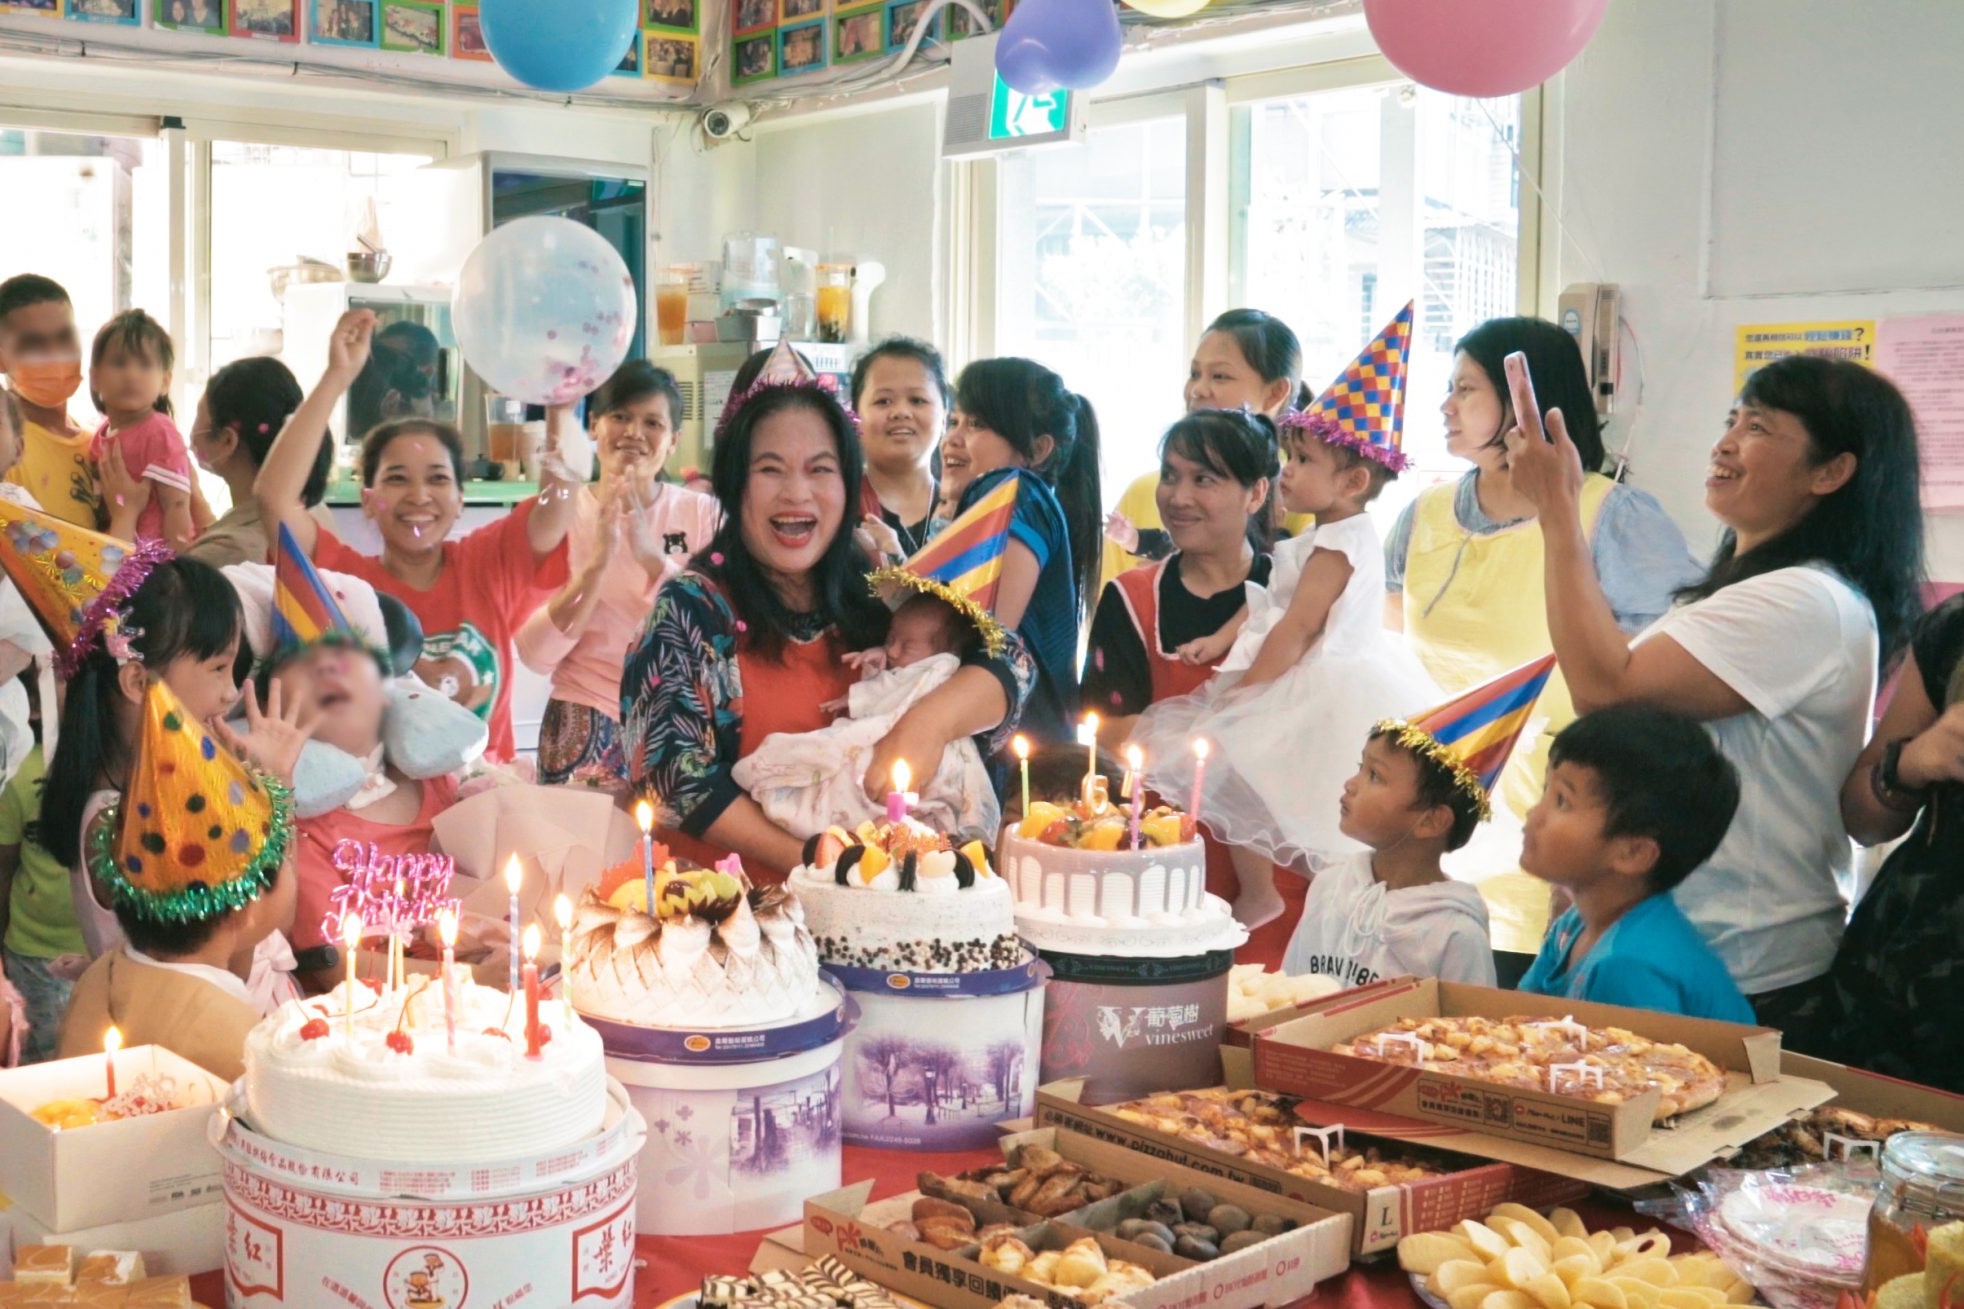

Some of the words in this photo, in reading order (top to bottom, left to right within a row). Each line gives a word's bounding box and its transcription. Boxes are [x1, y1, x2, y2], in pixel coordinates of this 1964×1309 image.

[333, 838, 455, 898] Happy
[1310, 955, 1344, 977] BRAV
[1146, 1004, 1199, 1028] 葡萄樹
[1145, 1024, 1214, 1046] vinesweet
[1562, 1113, 1585, 1128] LINE
[1095, 1126, 1245, 1184] www.pizzahut.comtw
[1381, 1206, 1392, 1226] L
[902, 1250, 1022, 1301] 會員獨享回饋
